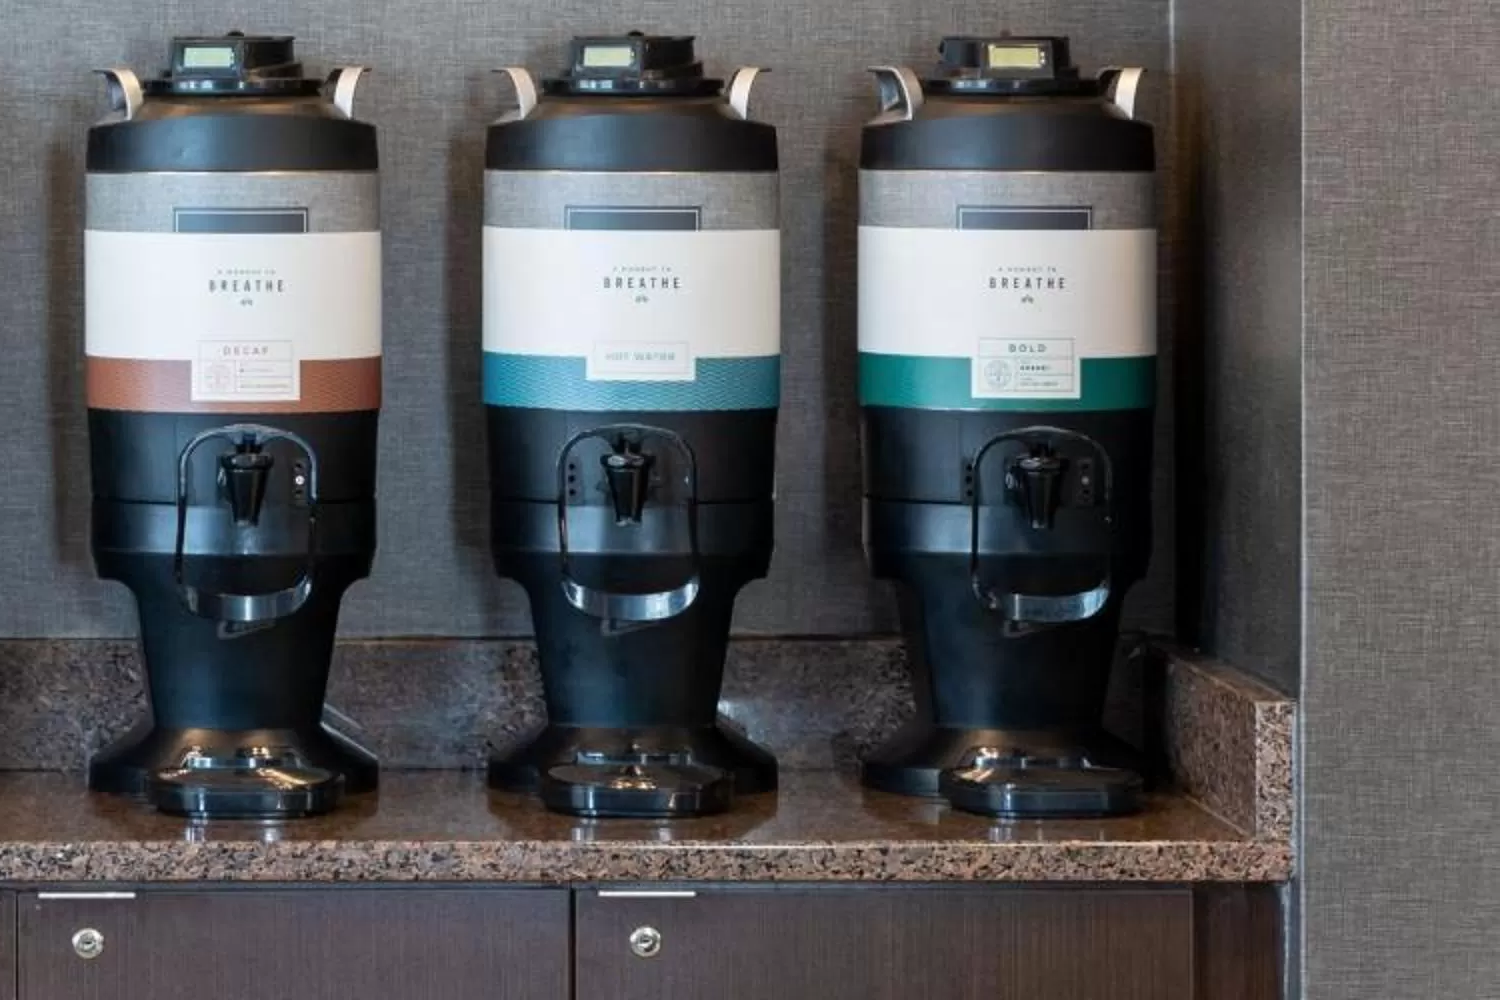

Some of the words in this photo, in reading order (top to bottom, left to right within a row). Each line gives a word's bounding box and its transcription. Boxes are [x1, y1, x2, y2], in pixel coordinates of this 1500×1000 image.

[208, 279, 284, 293] BREATHE
[603, 276, 681, 289] BREATHE
[988, 276, 1066, 289] BREATHE
[1008, 343, 1047, 353] BOLD
